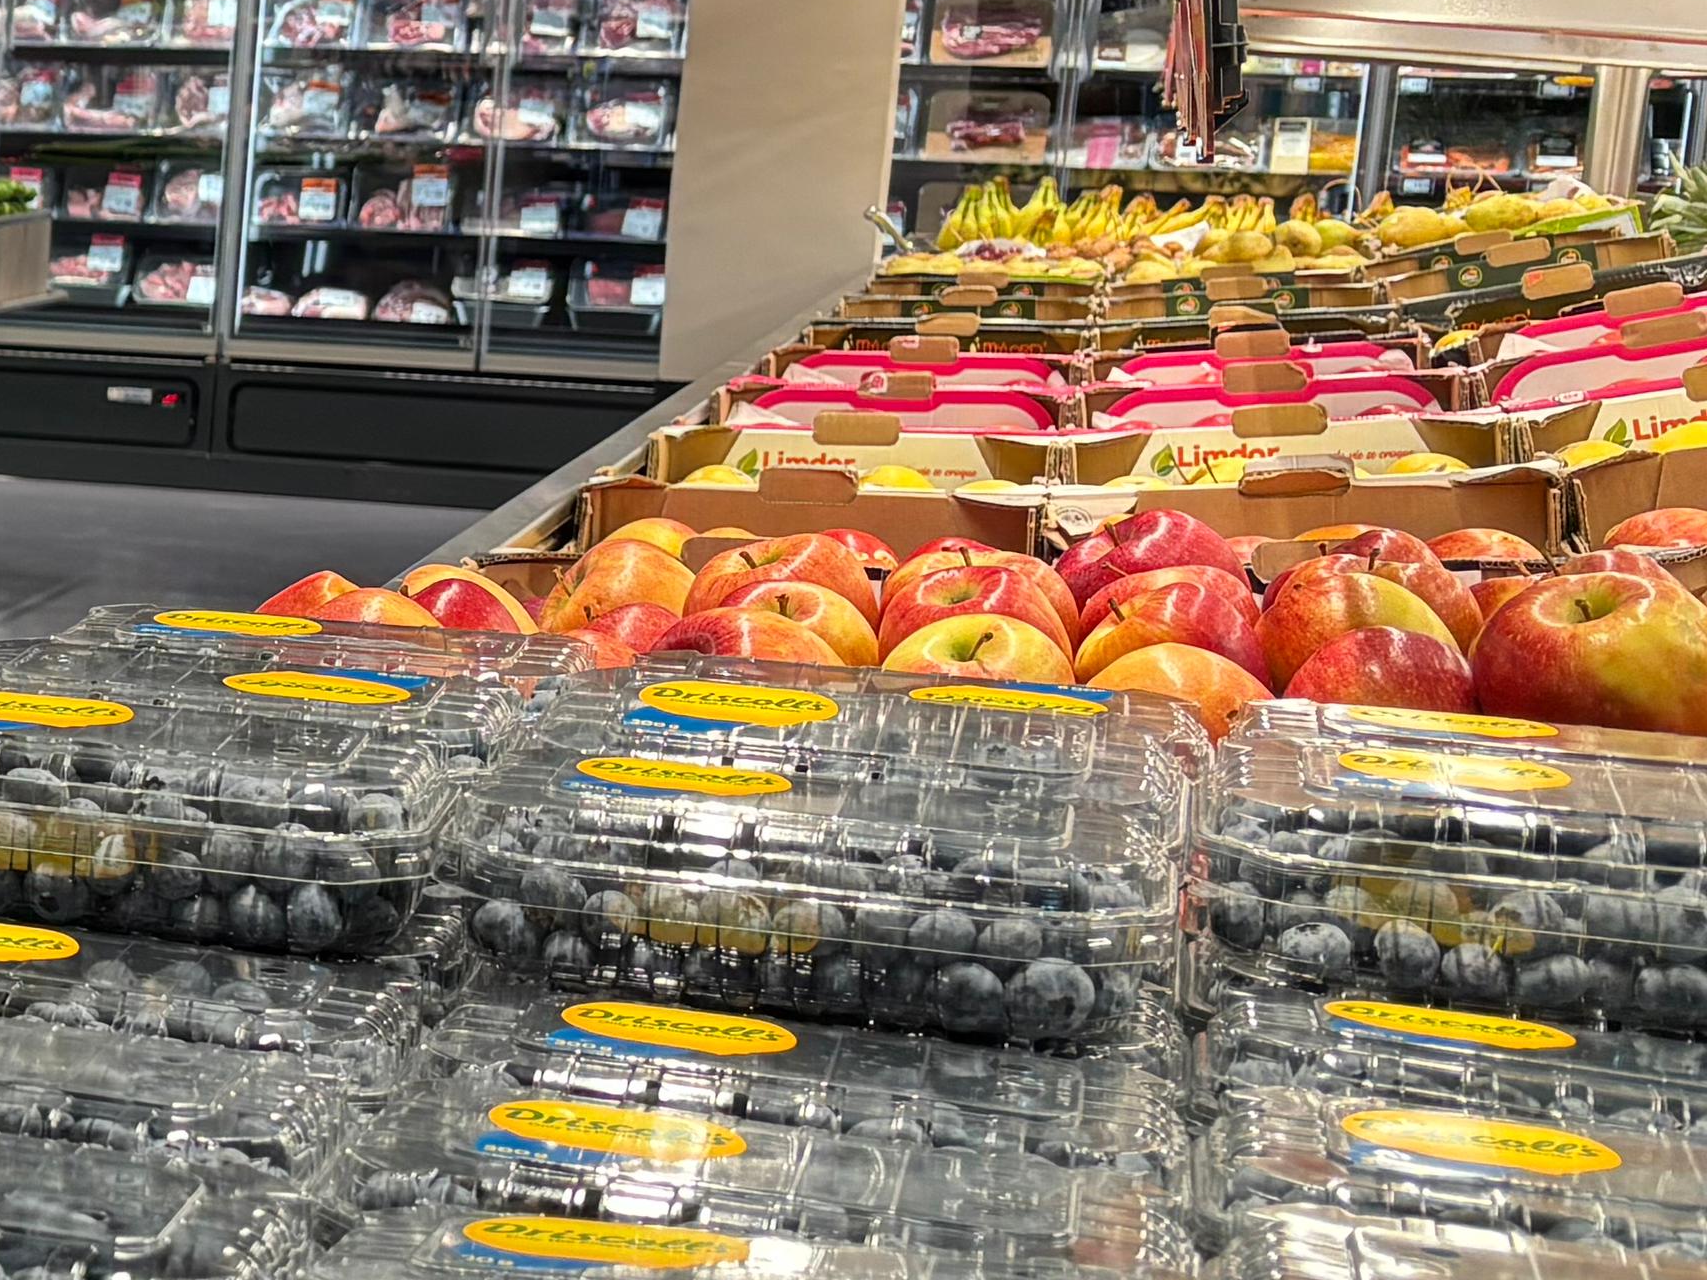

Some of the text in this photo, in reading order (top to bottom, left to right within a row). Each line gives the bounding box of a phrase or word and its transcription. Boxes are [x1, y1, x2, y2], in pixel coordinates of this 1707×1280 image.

[652, 686, 829, 712] Driscoll's
[590, 760, 775, 786] Driscoll's
[576, 1006, 790, 1044] Driscoll's
[1341, 1004, 1557, 1040] Driscoll's
